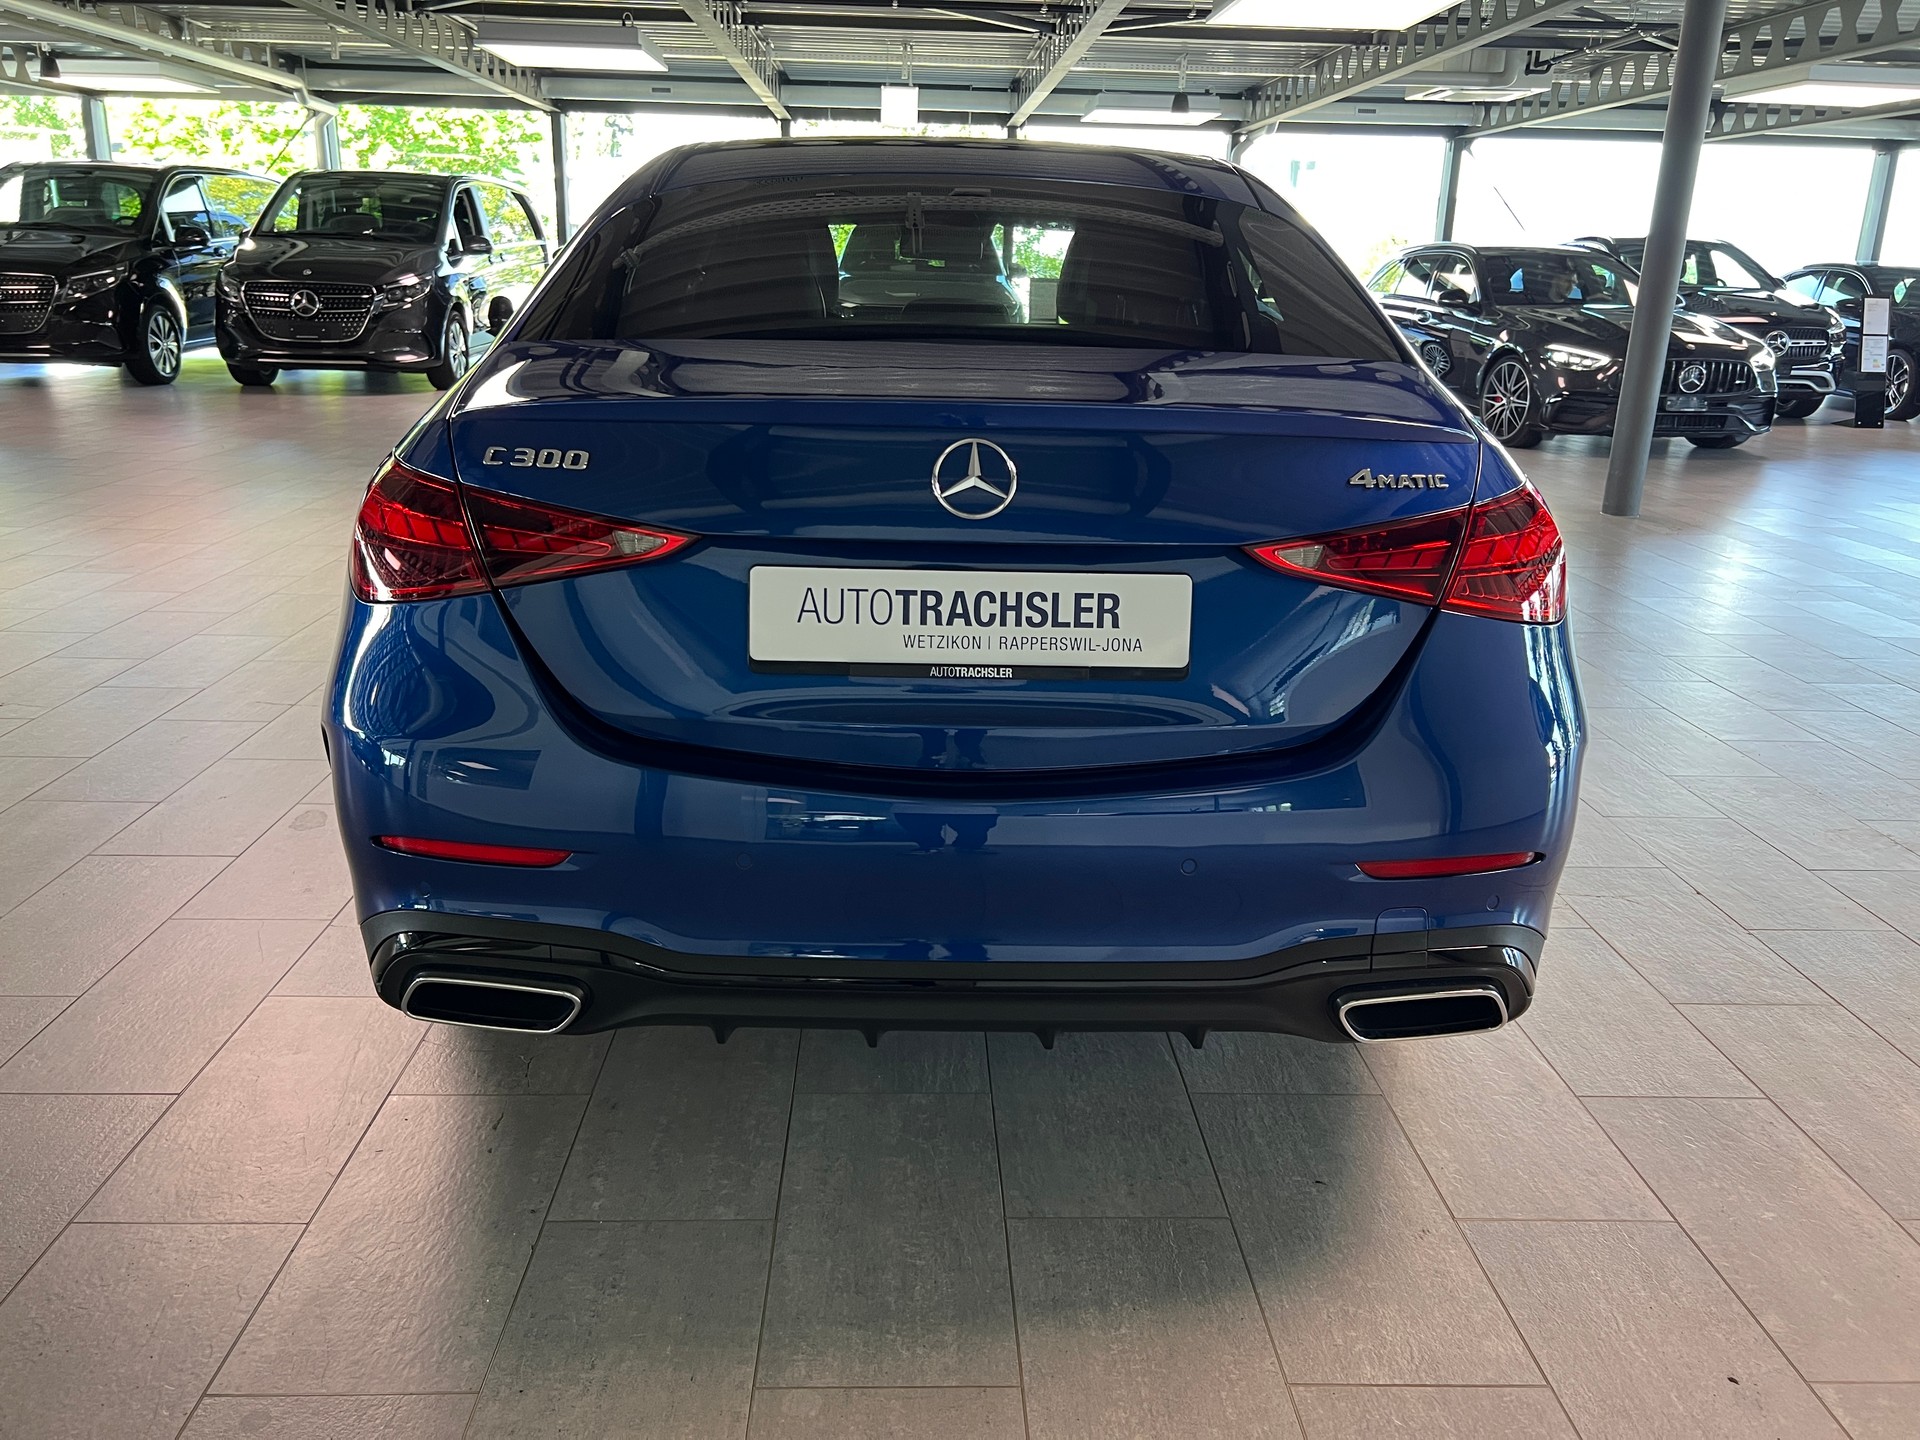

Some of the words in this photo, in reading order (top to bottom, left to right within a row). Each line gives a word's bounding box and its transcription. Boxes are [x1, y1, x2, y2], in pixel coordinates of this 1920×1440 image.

[482, 446, 508, 465] C
[509, 447, 590, 470] 300
[1349, 467, 1450, 489] 4MATIC
[796, 587, 1121, 630] AUTOTRACHSLER
[903, 634, 982, 650] WETZIKON
[999, 635, 1143, 652] RAPPERSWIL-JONA
[929, 665, 1013, 679] AUTOTRACHSLER
